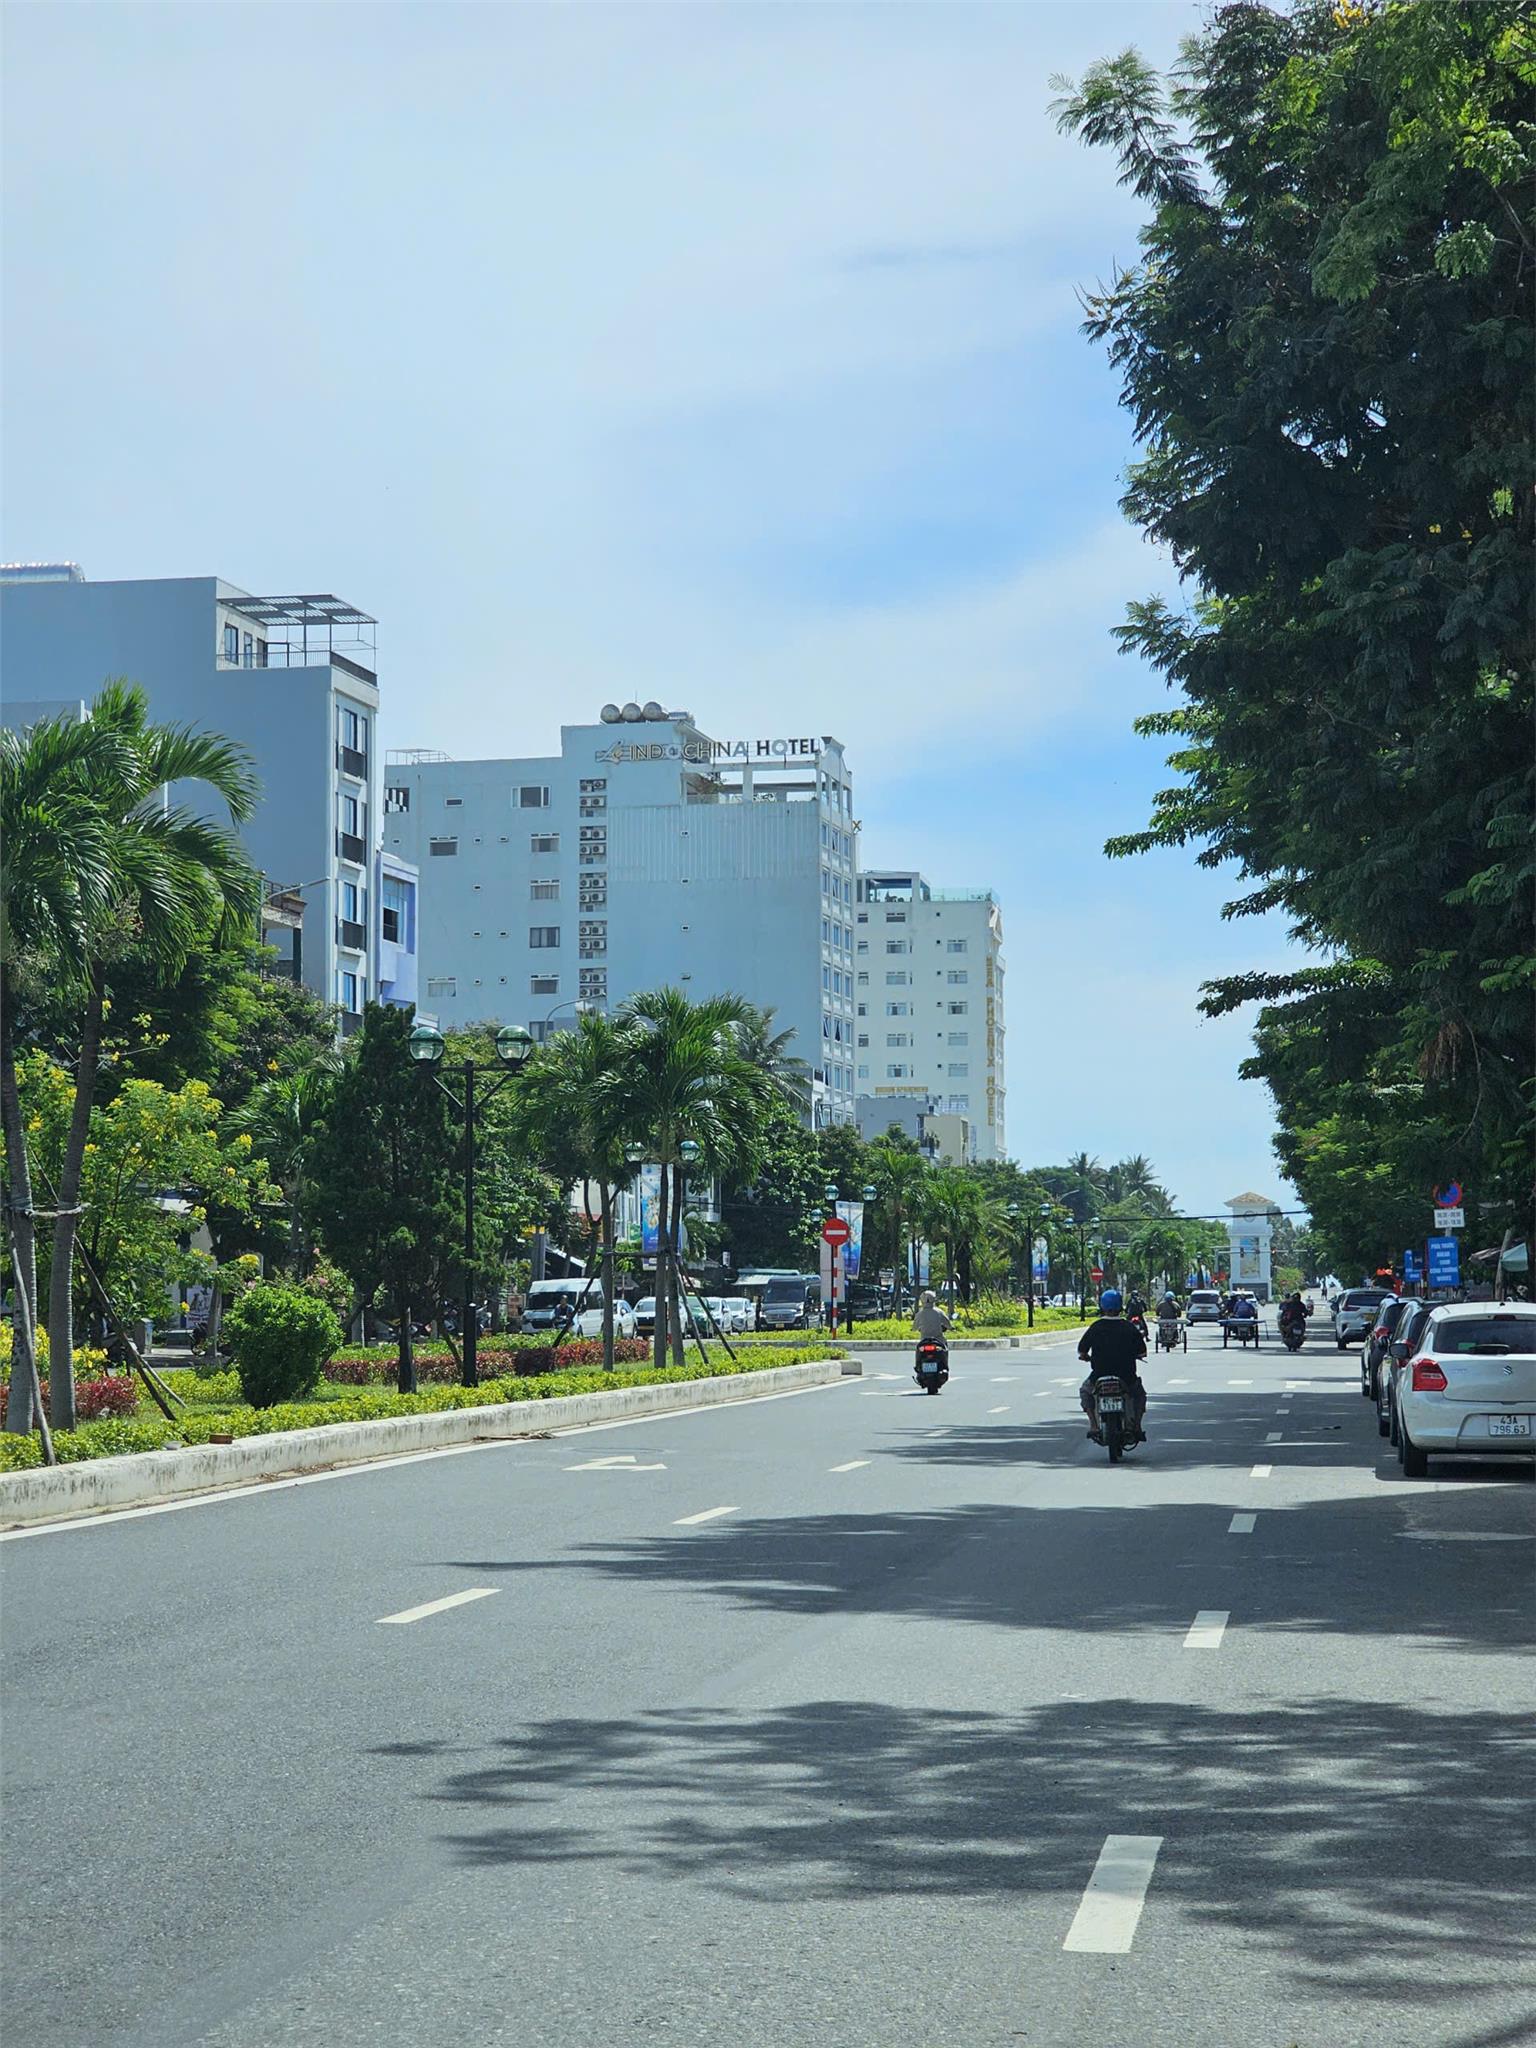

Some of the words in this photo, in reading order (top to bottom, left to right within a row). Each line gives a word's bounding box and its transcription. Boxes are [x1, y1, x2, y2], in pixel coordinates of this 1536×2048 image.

[631, 741, 748, 761] INDOCHINA
[756, 738, 819, 756] HOTEL
[987, 1076, 995, 1127] HOTEL
[1500, 1415, 1518, 1425] 43A
